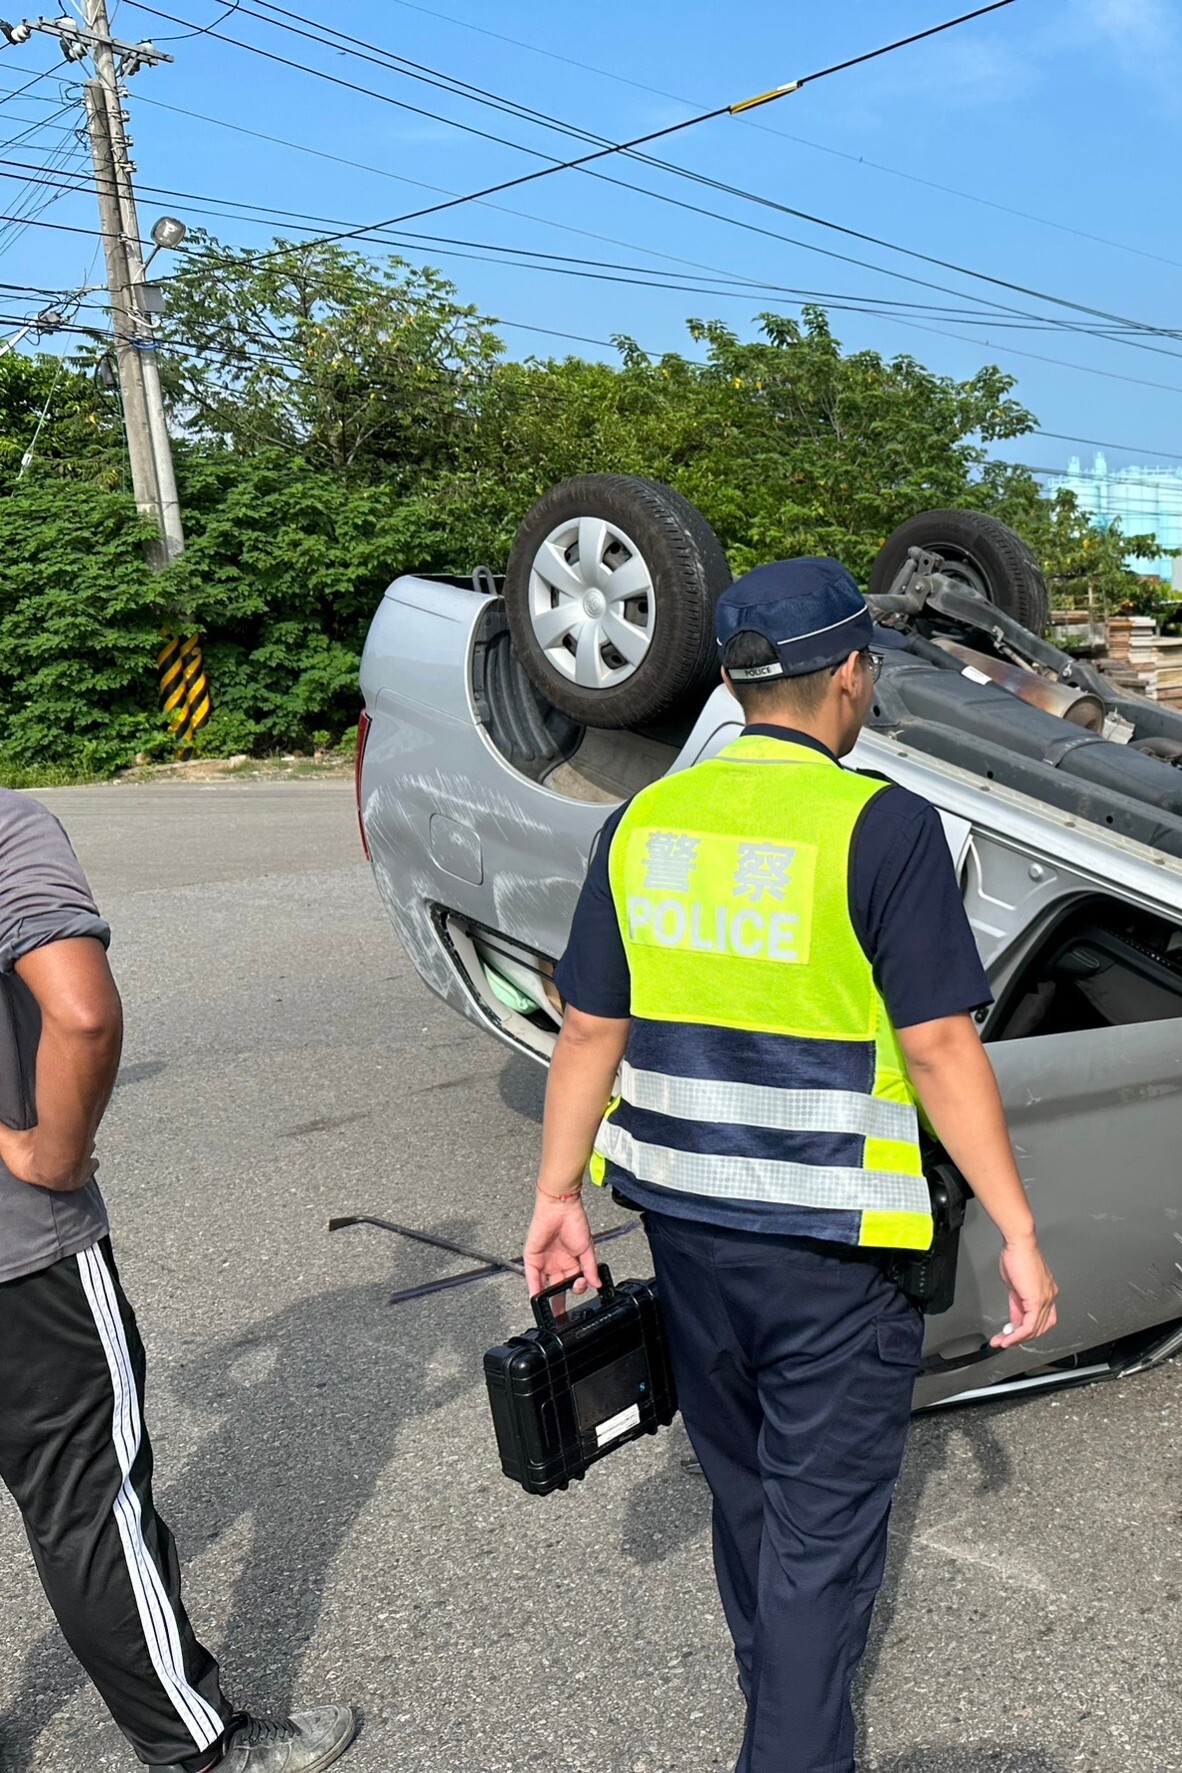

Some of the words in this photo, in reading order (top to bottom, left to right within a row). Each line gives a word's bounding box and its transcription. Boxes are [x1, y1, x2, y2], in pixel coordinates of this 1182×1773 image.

[744, 666, 772, 677] POLICE
[642, 831, 796, 901] 警察
[628, 894, 800, 961] POLICE
